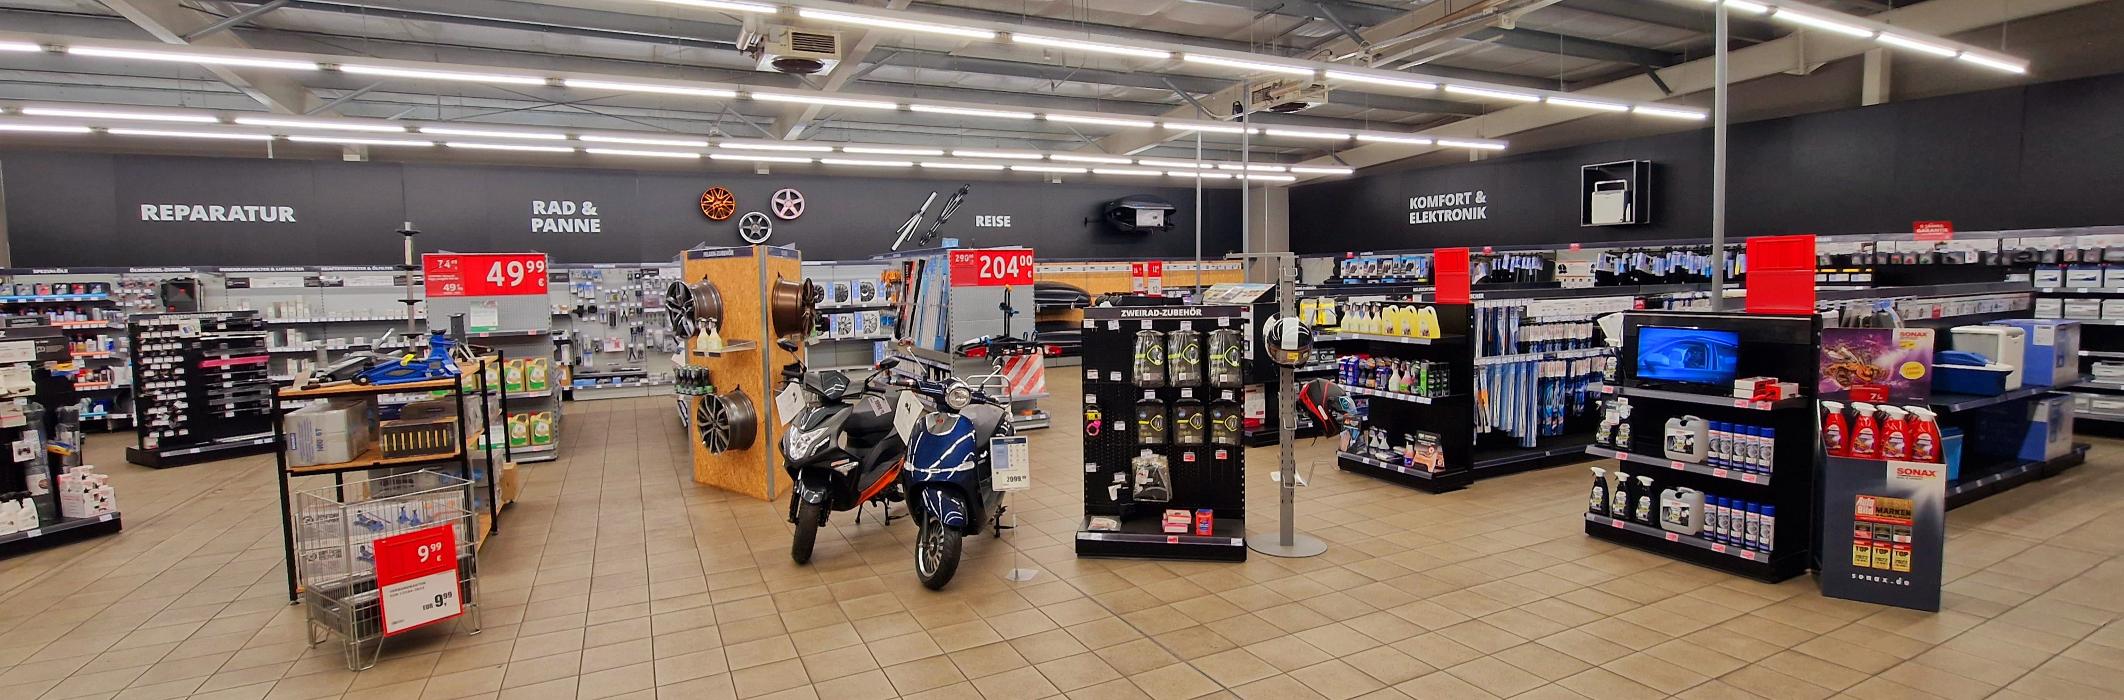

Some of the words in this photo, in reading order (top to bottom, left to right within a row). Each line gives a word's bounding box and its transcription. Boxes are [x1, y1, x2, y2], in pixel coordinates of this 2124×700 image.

[1409, 192, 1472, 210] KOMFORT
[1475, 190, 1487, 205] &
[140, 203, 297, 223] REPARATUR
[532, 200, 577, 216] RAD
[581, 200, 598, 216] &
[975, 215, 1011, 228] REISE
[1409, 205, 1487, 225] ELEKTRONIK
[531, 217, 601, 233] PANNE
[1120, 307, 1203, 317] ZWEIRAD-ZUBEHÖR
[1896, 467, 1937, 478] SONAX
[1875, 506, 1912, 516] MARKEN
[1851, 573, 1910, 586] sonax.de
[422, 602, 434, 611] EUR
